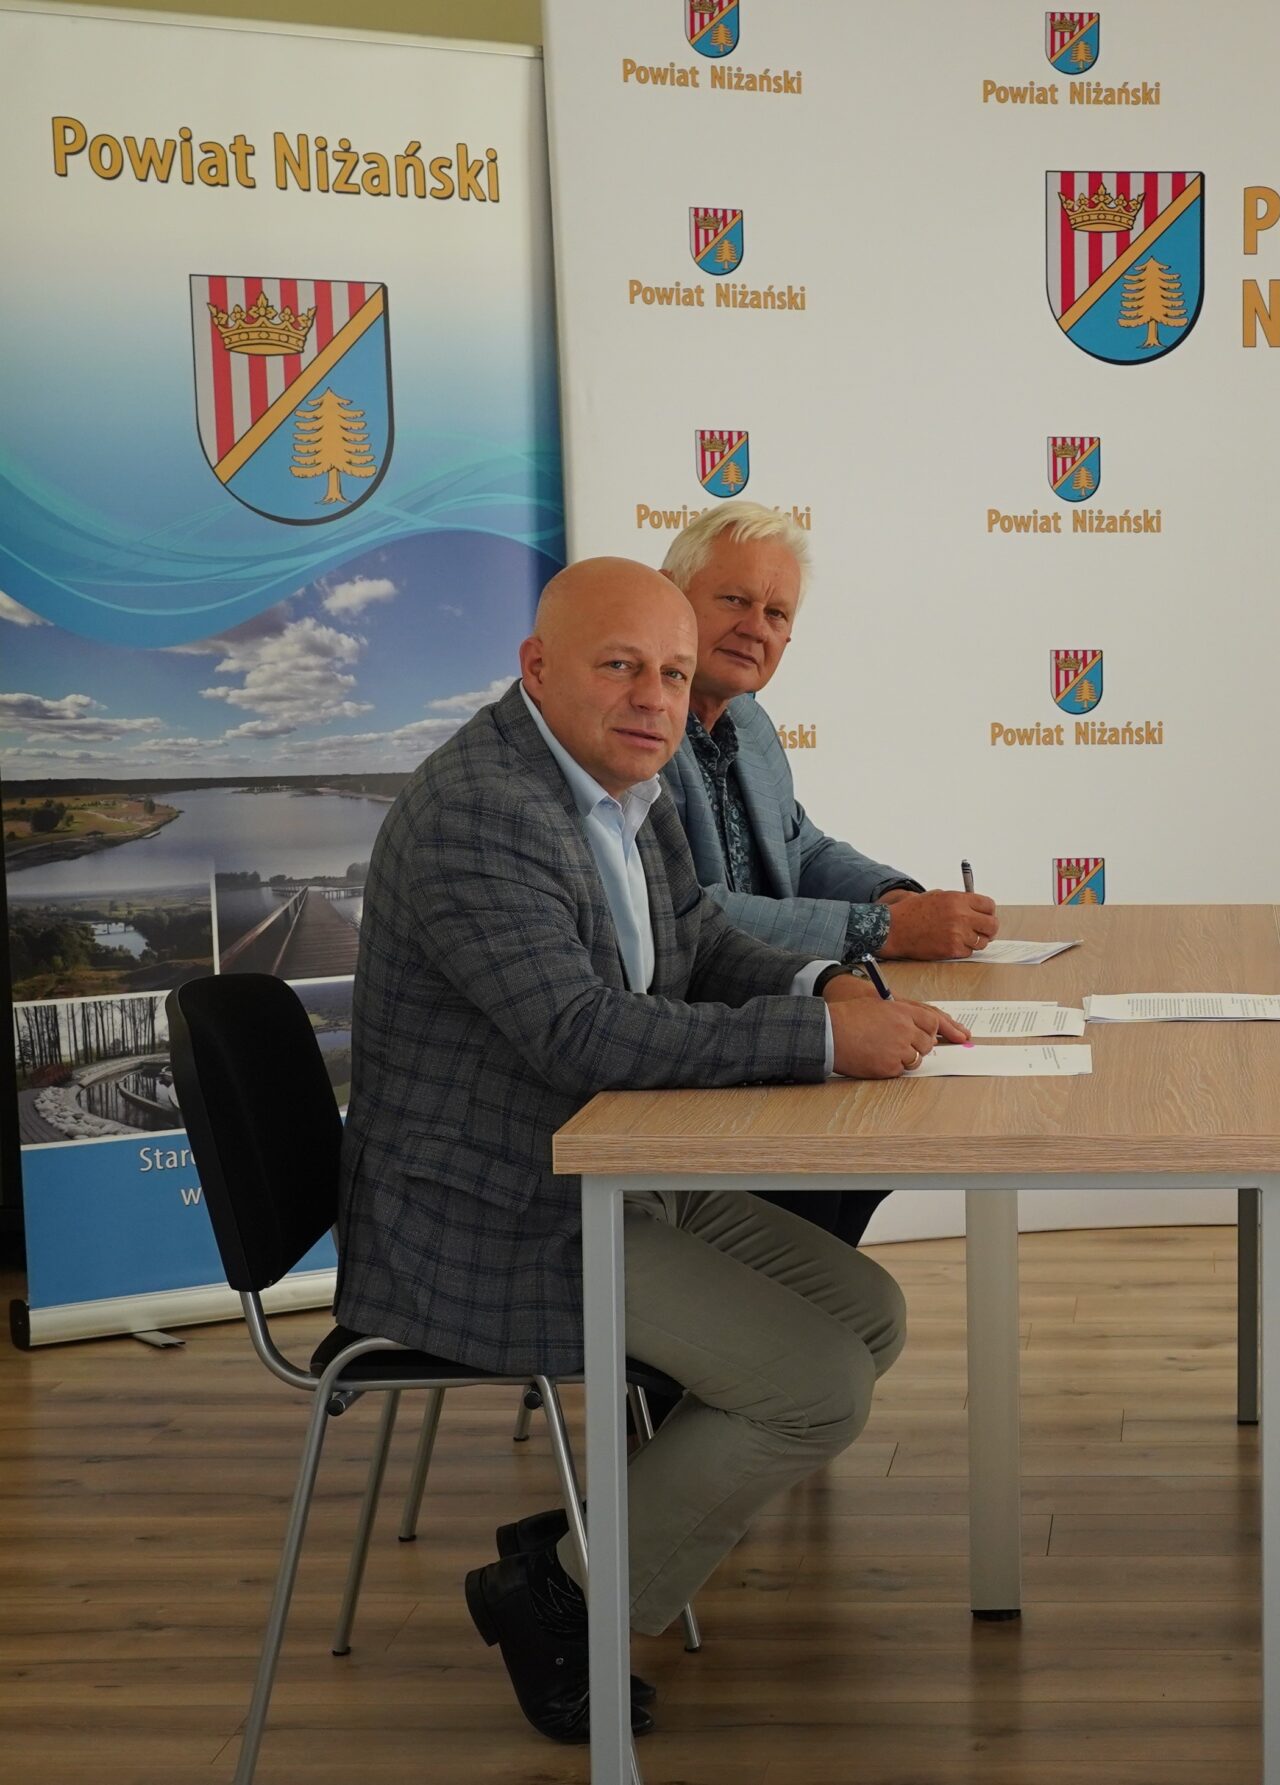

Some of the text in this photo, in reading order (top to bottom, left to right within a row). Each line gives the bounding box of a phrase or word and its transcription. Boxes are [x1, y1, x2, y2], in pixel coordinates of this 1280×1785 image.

[622, 59, 803, 94] Powiat Niżański
[982, 79, 1161, 106] Powiat Niżański
[51, 116, 501, 203] Powiat Niżański
[628, 279, 806, 311] Powiat Niżański
[636, 503, 708, 530] Powia
[987, 508, 1162, 534] Powiat Niżański
[990, 720, 1164, 747] Powiat Niżański
